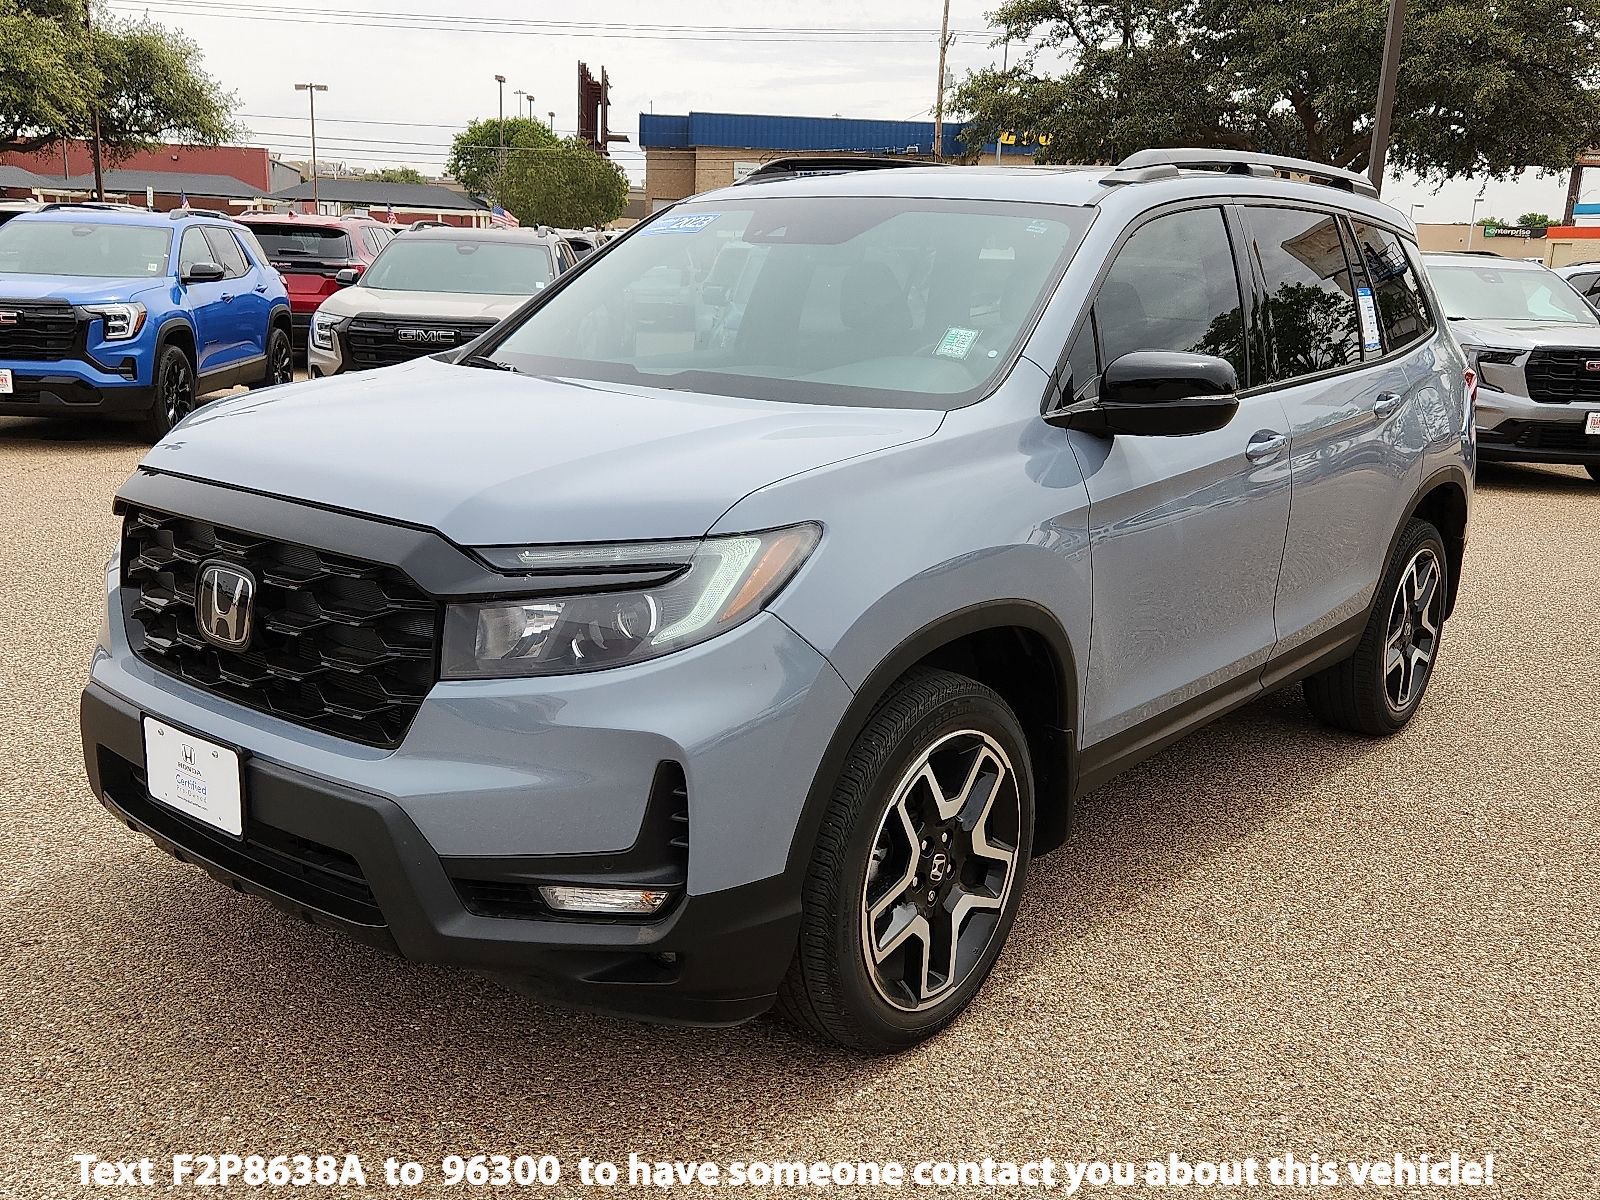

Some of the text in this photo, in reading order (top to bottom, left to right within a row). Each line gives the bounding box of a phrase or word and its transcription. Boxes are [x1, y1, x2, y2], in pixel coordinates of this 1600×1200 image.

[398, 329, 455, 343] GMC
[177, 762, 202, 777] HONDA
[175, 774, 207, 796] Certified
